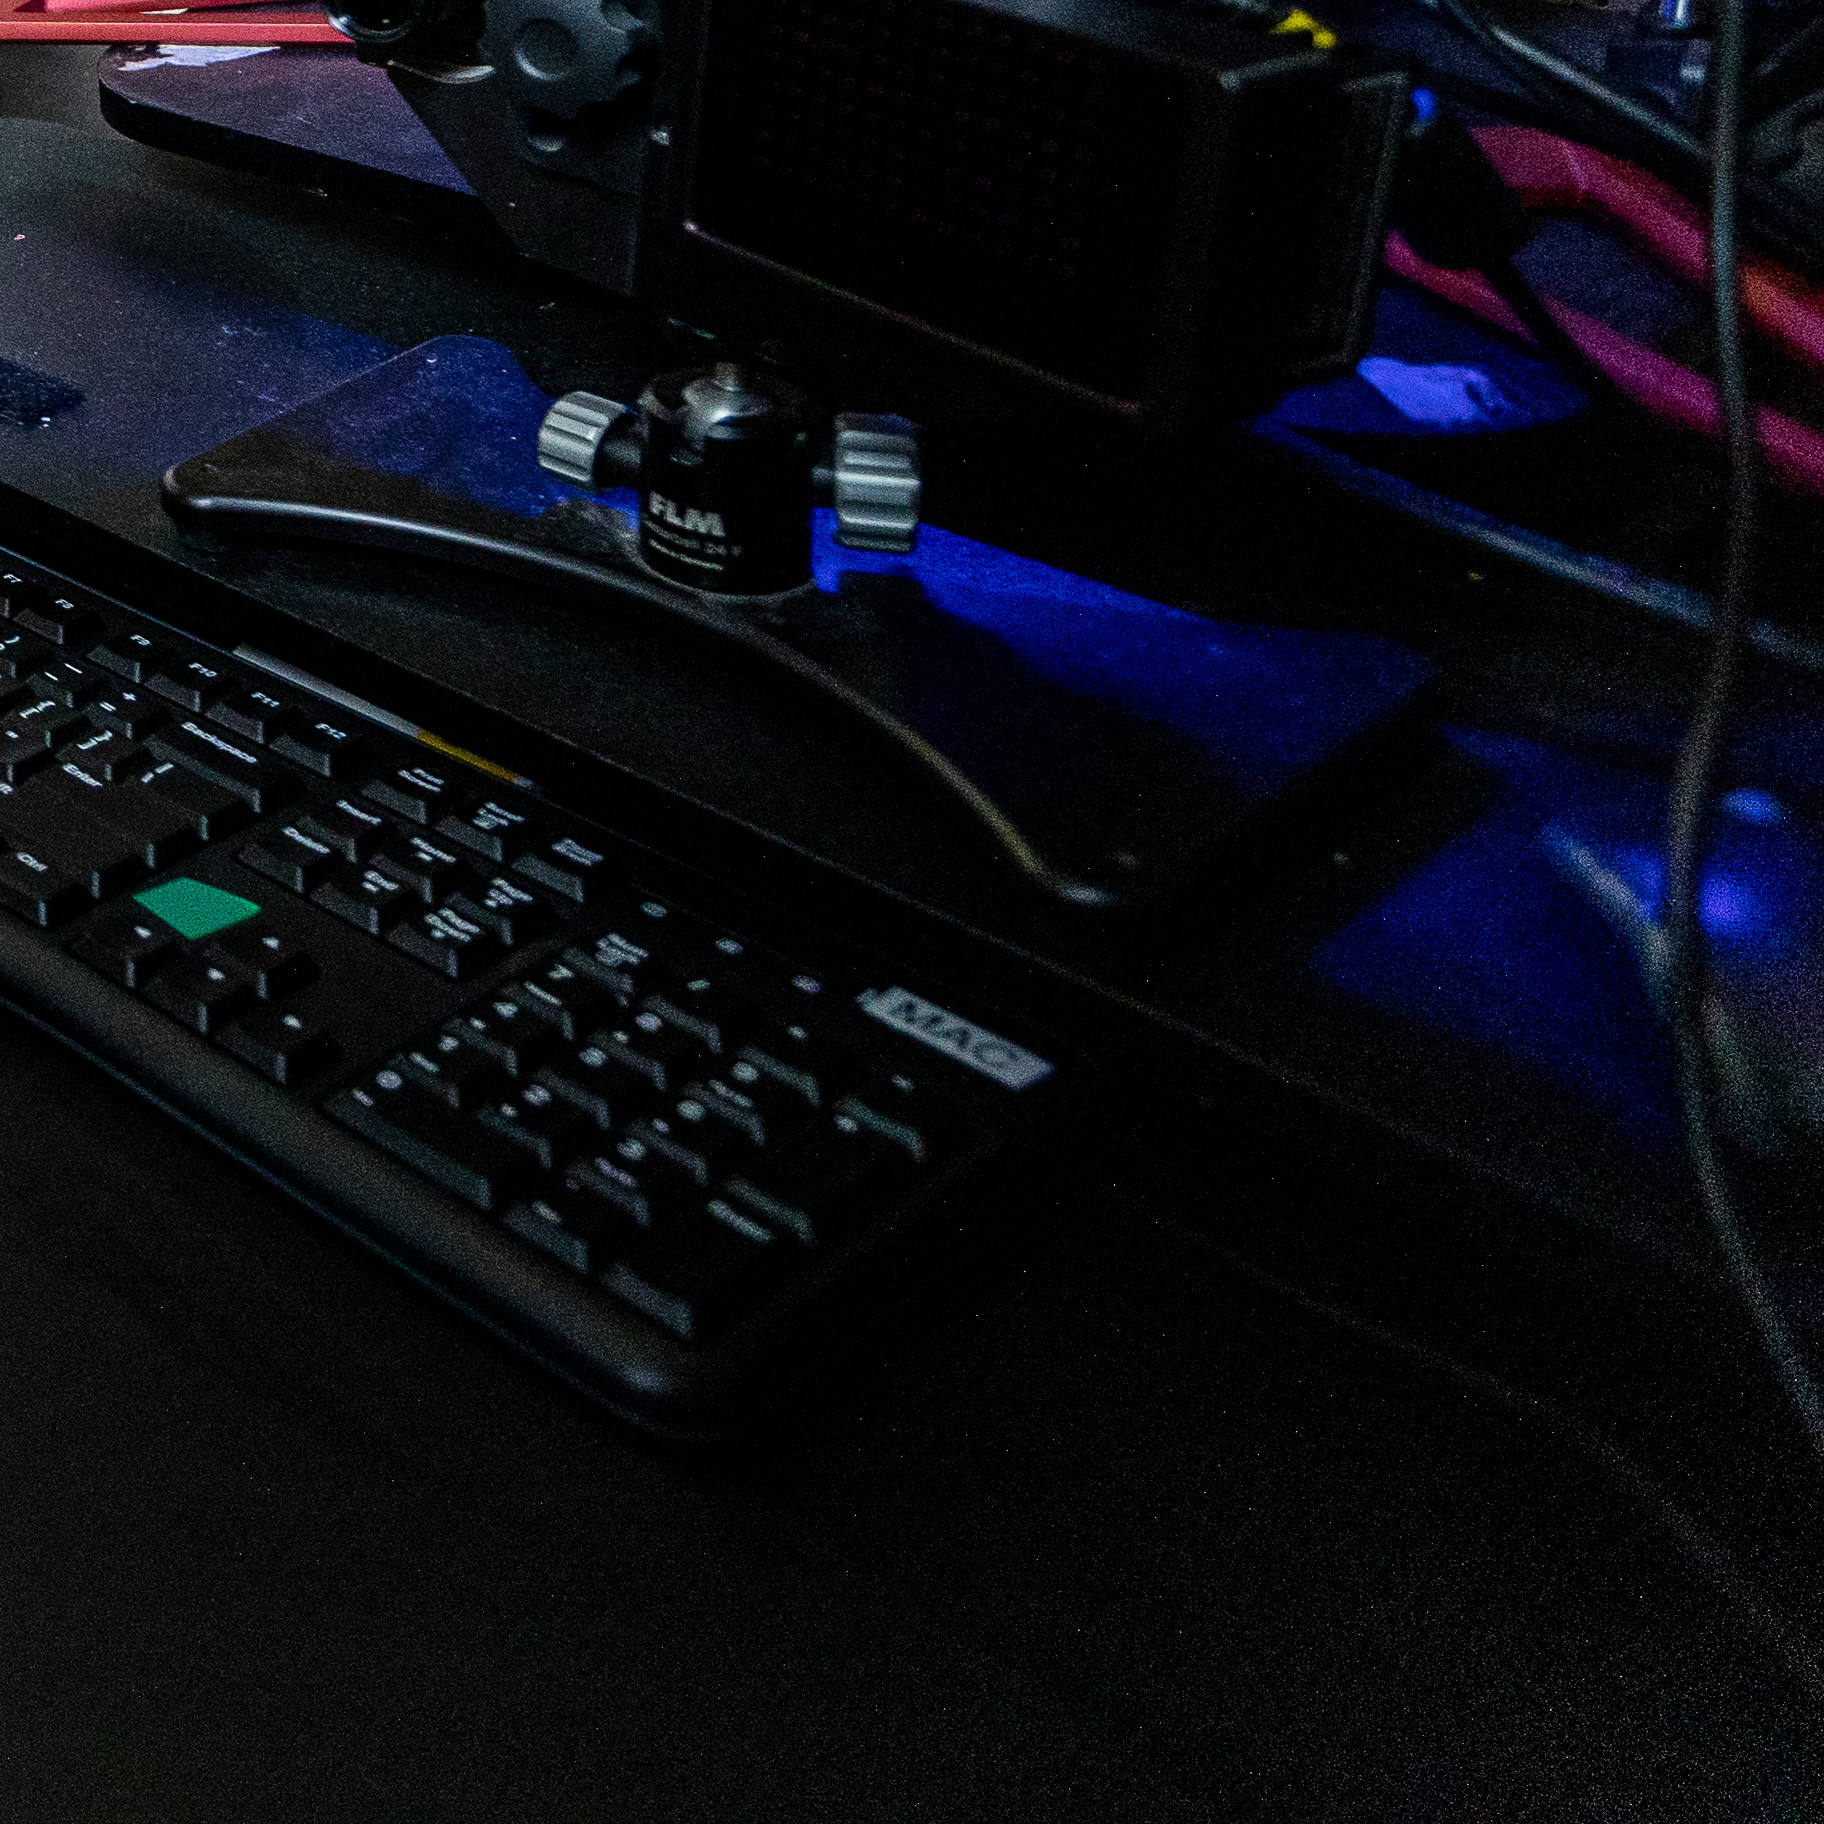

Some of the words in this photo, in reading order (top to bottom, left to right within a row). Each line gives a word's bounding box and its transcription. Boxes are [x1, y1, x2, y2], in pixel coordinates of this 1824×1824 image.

[649, 490, 726, 538] FLM
[3, 574, 21, 583] F7
[189, 663, 217, 677] F10
[252, 692, 279, 707] F11
[316, 723, 346, 739] F12
[182, 722, 257, 763] Backspace
[63, 763, 102, 786] Enter
[17, 853, 47, 871] Ctrl
